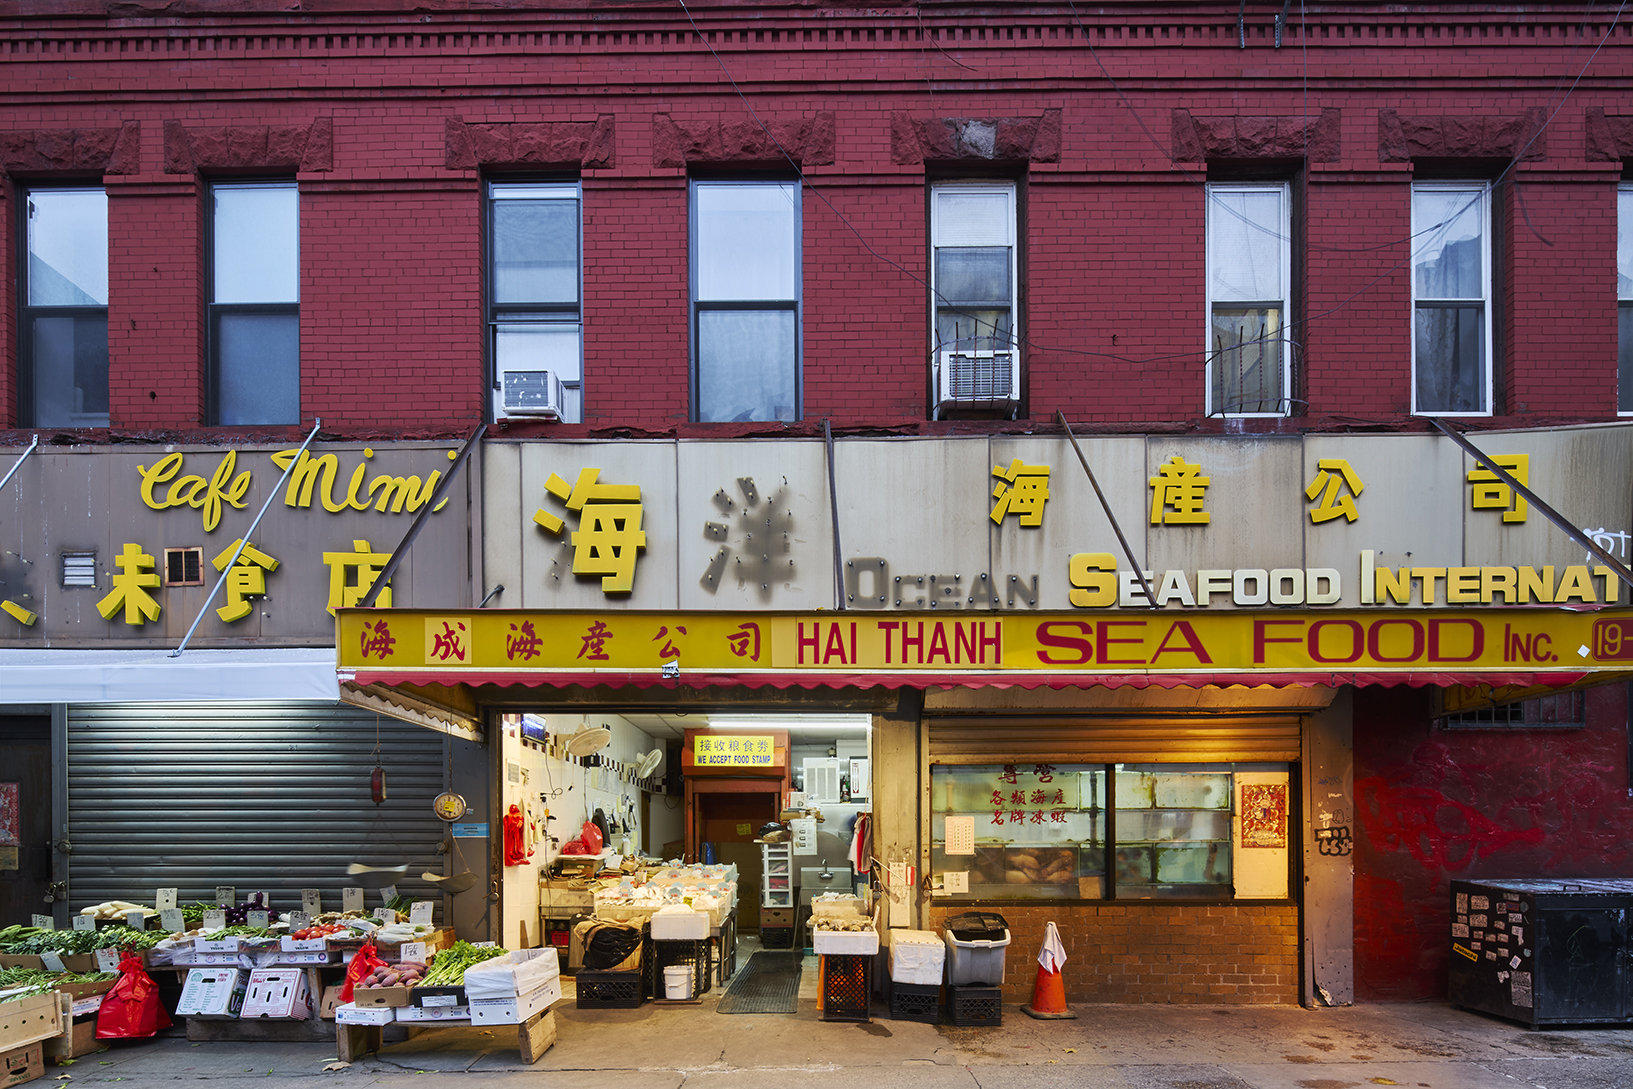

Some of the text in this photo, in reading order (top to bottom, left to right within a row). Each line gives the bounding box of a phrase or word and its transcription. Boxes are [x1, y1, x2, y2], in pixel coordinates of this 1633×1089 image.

[137, 447, 449, 532] Cafe Mimi
[798, 621, 857, 665] HAI
[878, 621, 1002, 665] THANH
[1036, 620, 1214, 665] SEA
[1253, 618, 1485, 664] FOOD
[697, 755, 771, 764] WE ACCEPT FOOD STAMP
